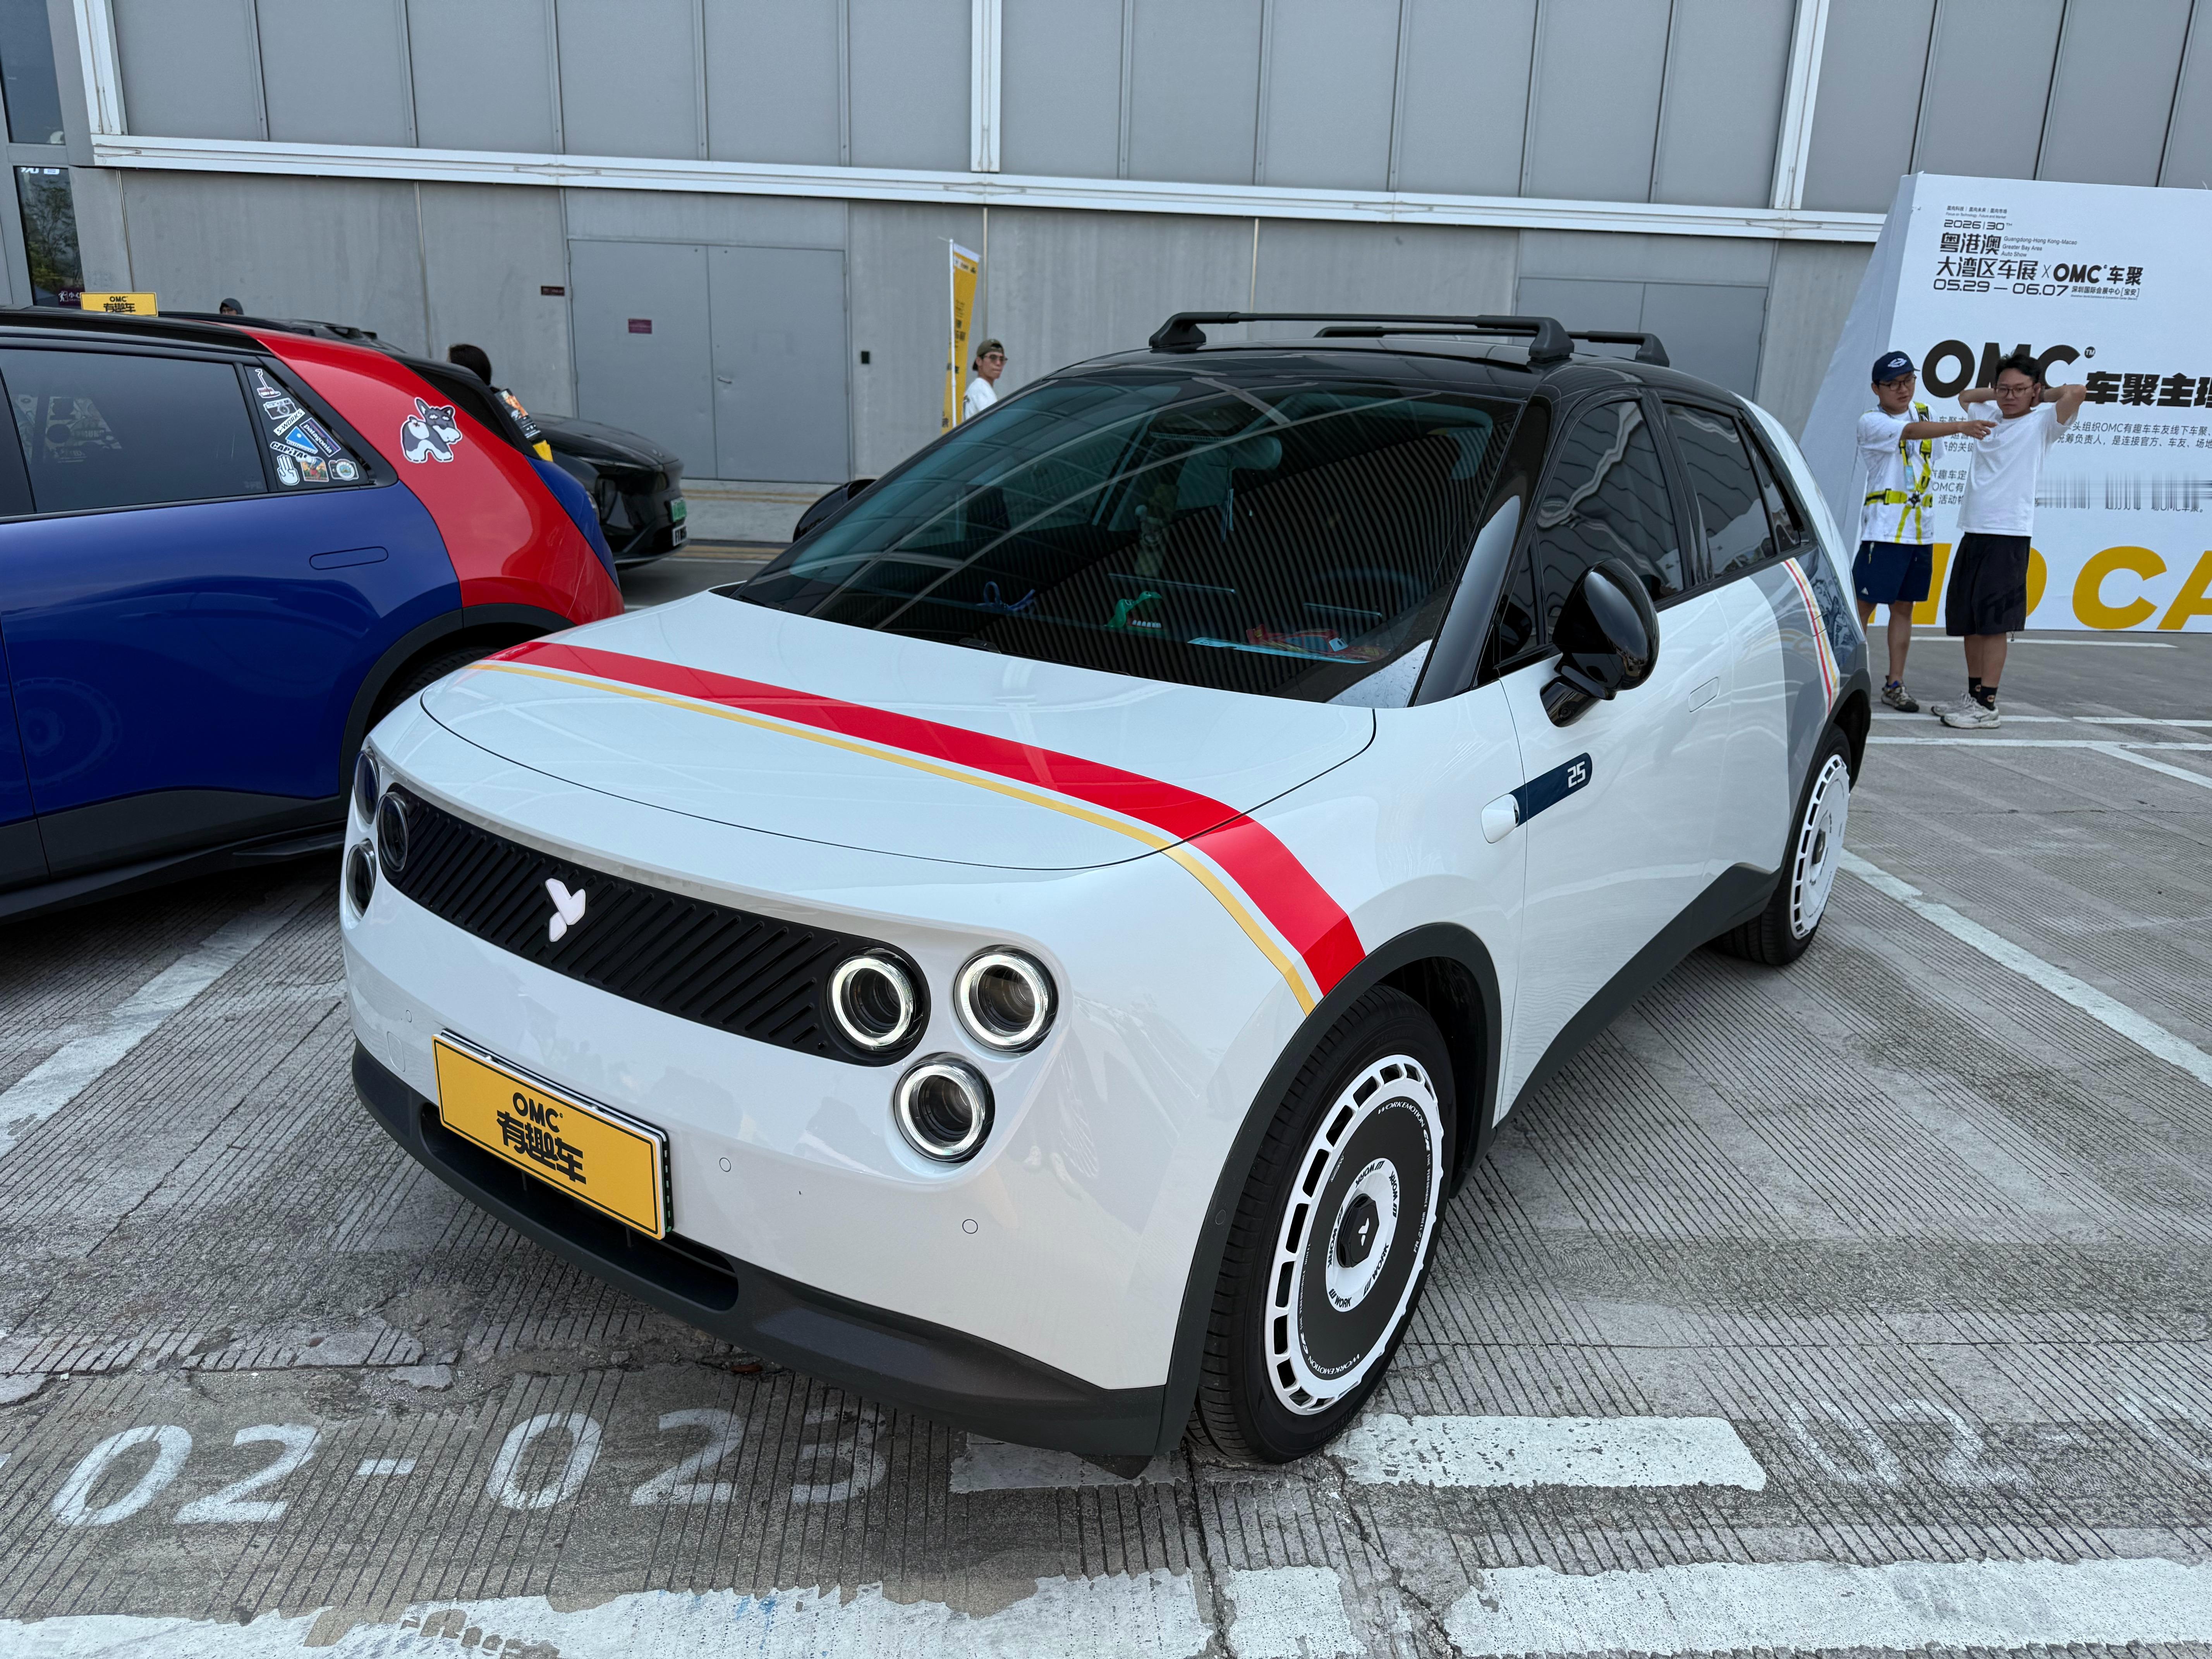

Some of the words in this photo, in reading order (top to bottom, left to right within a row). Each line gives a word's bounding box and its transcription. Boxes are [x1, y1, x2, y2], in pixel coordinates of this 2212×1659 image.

[1940, 232, 2002, 255] 粤港澳
[2004, 236, 2046, 245] Guangdong-Hong
[1936, 256, 2039, 280] 大湾区车展
[2053, 263, 2102, 283] OMC
[2107, 265, 2143, 286] 车聚
[1933, 279, 1990, 292] 05.29
[2013, 283, 2069, 296] 06.07
[277, 410, 302, 434] S-WORKS
[2068, 421, 2211, 436] 头组织OMC有趣车车友线下车聚、
[303, 424, 332, 453] patagonia
[1567, 761, 1586, 788] 25
[512, 1092, 560, 1133] OMC
[1401, 1102, 1425, 1128] EMOTION
[496, 1109, 587, 1185] 有趣车
[1355, 1163, 1375, 1188] WORK
[1389, 1170, 1398, 1202] WORK
[1328, 1228, 1338, 1269] WORK
[1372, 1243, 1389, 1280] WORK
[1334, 1296, 1352, 1308] WORK
[1308, 1356, 1335, 1374] EMOTION
